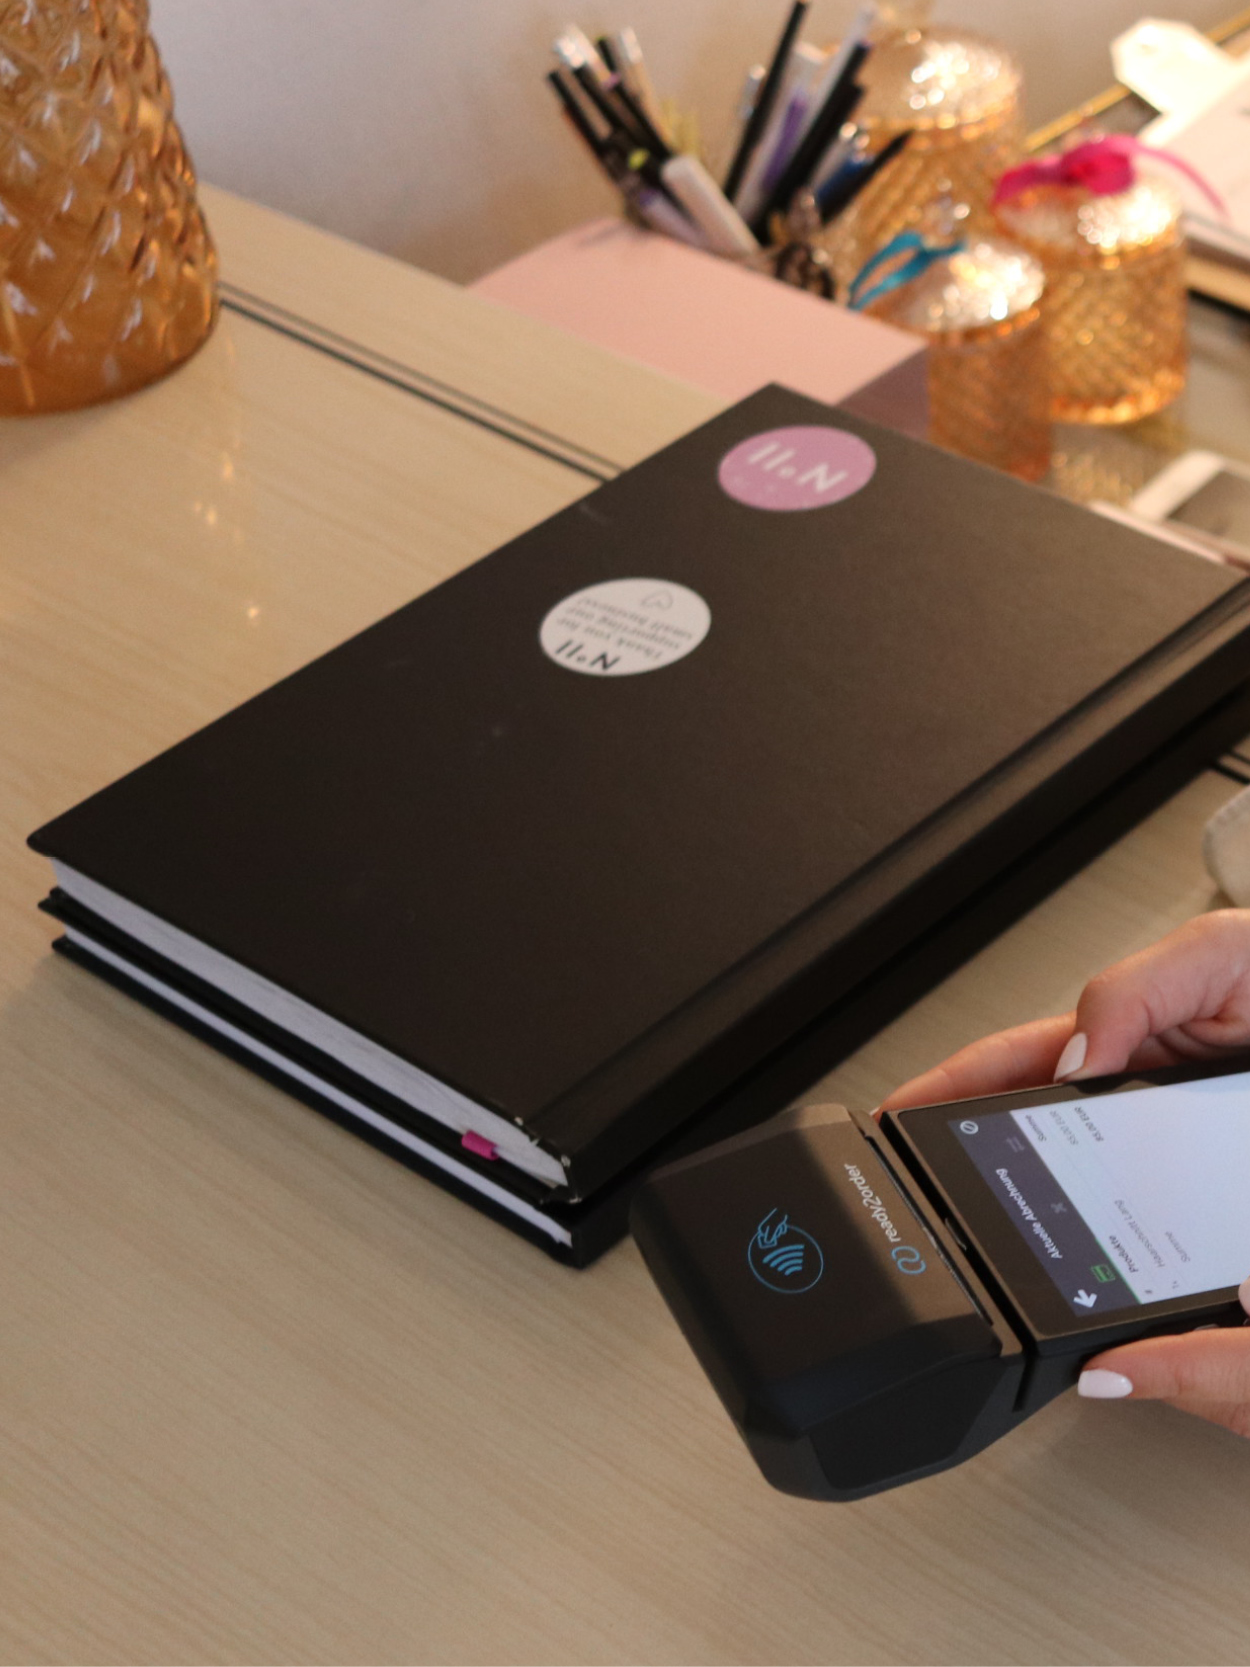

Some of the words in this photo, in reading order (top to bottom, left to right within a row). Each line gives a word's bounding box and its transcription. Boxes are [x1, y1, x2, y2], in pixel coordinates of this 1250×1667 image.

[1024, 1114, 1047, 1143] Summe
[1049, 1110, 1065, 1128] EUR
[1073, 1105, 1090, 1123] EUR
[843, 1163, 902, 1243] ready2order
[995, 1167, 1037, 1221] Abrechnung
[1114, 1199, 1133, 1221] Lang
[1032, 1221, 1063, 1260] Aktuelle
[1108, 1234, 1139, 1274] Produkte
[1128, 1220, 1166, 1268] Haarschnitt
[1164, 1230, 1191, 1263] Summe
